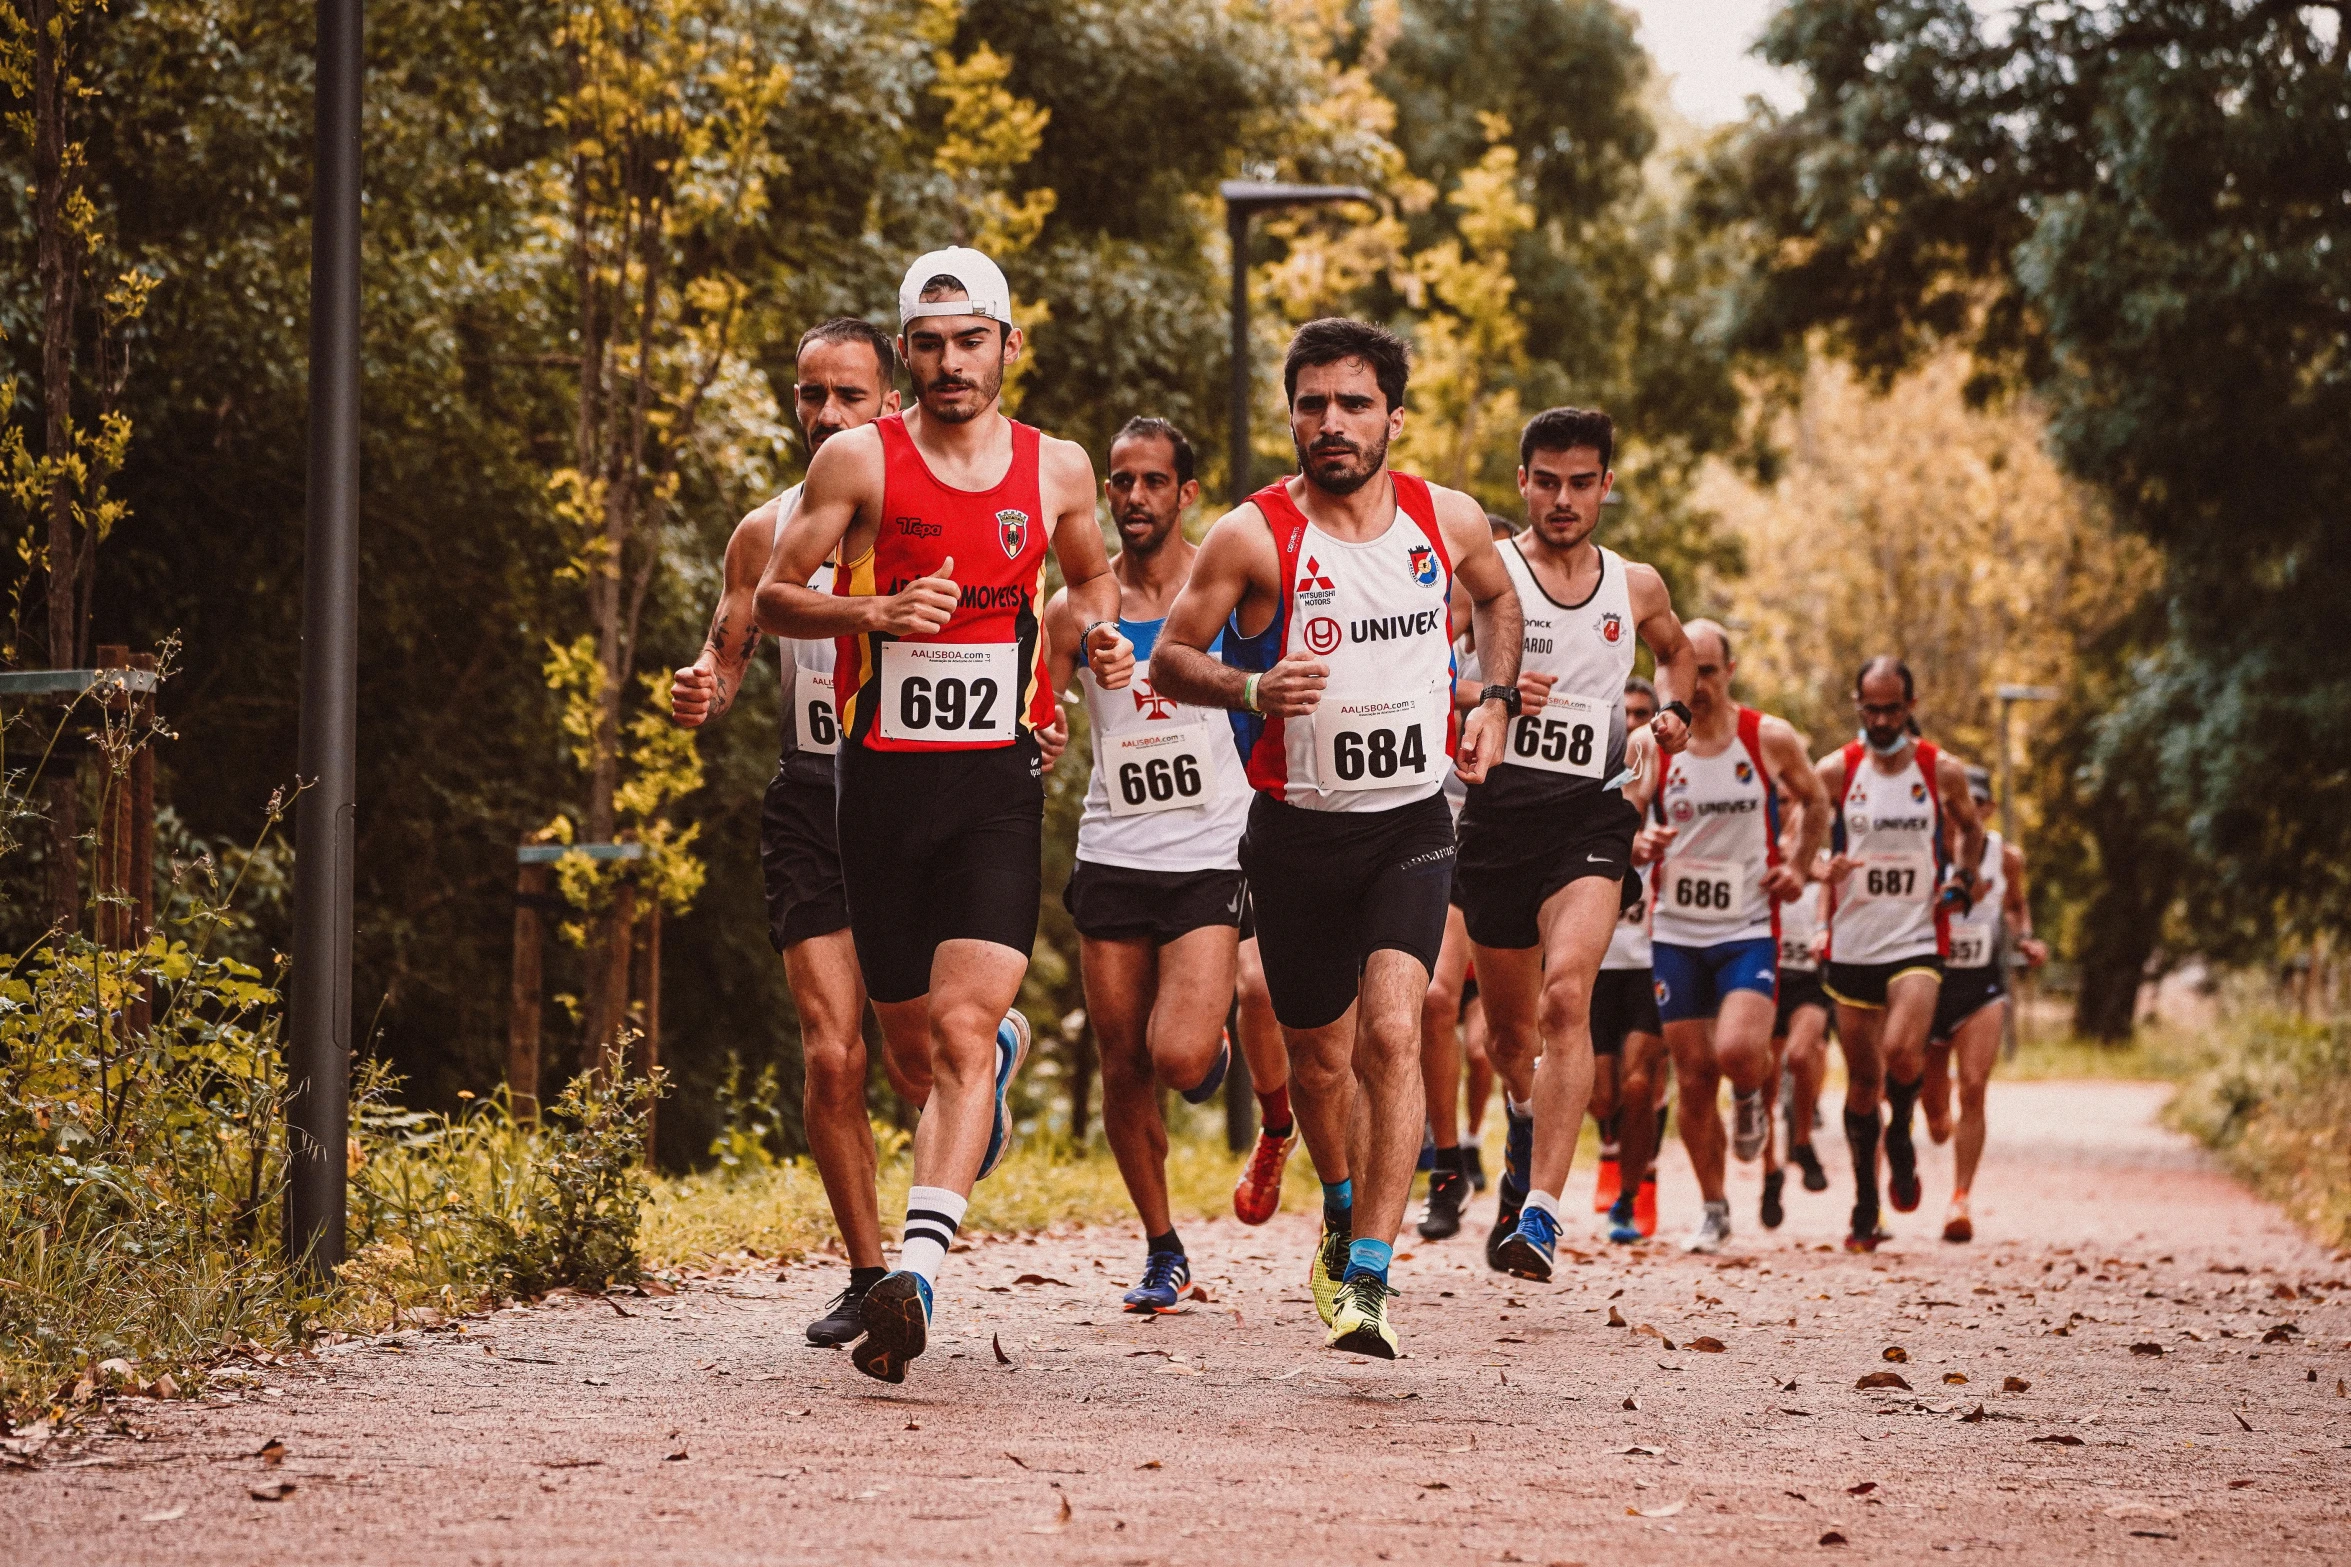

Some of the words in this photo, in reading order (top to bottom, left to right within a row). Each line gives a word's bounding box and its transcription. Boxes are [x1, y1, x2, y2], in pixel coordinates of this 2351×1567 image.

[1299, 590, 1336, 600] MITSUBISHI
[1304, 598, 1331, 607] MOTORS
[1351, 608, 1440, 643] UNIVEX
[911, 649, 984, 660] AALISBOA.com
[900, 676, 998, 731] 692
[1340, 700, 1409, 714] AALISBOA.com
[1333, 723, 1427, 781] 684
[1513, 715, 1595, 766] 658
[1119, 753, 1202, 806] 666
[1676, 877, 1731, 911] 686
[1867, 867, 1916, 896] 687
